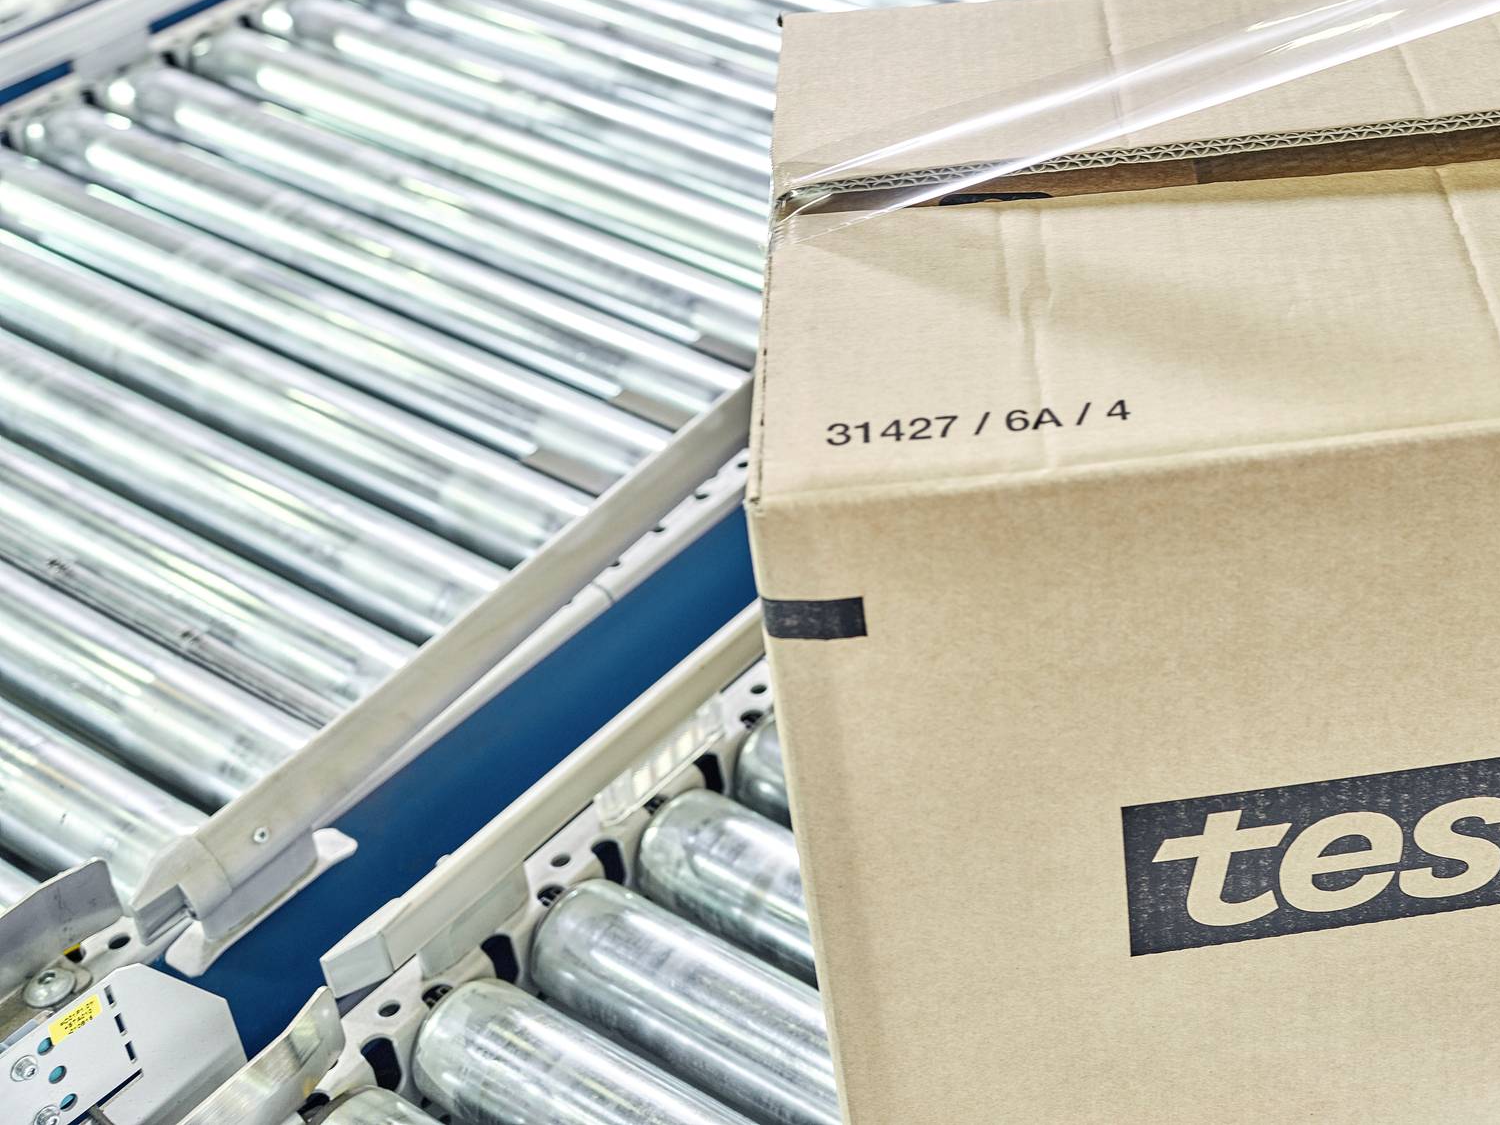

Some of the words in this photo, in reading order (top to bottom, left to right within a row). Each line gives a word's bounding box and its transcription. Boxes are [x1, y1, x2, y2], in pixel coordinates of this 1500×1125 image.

[826, 415, 958, 446] 31427
[1005, 408, 1063, 431] 6A
[1106, 399, 1131, 420] 4
